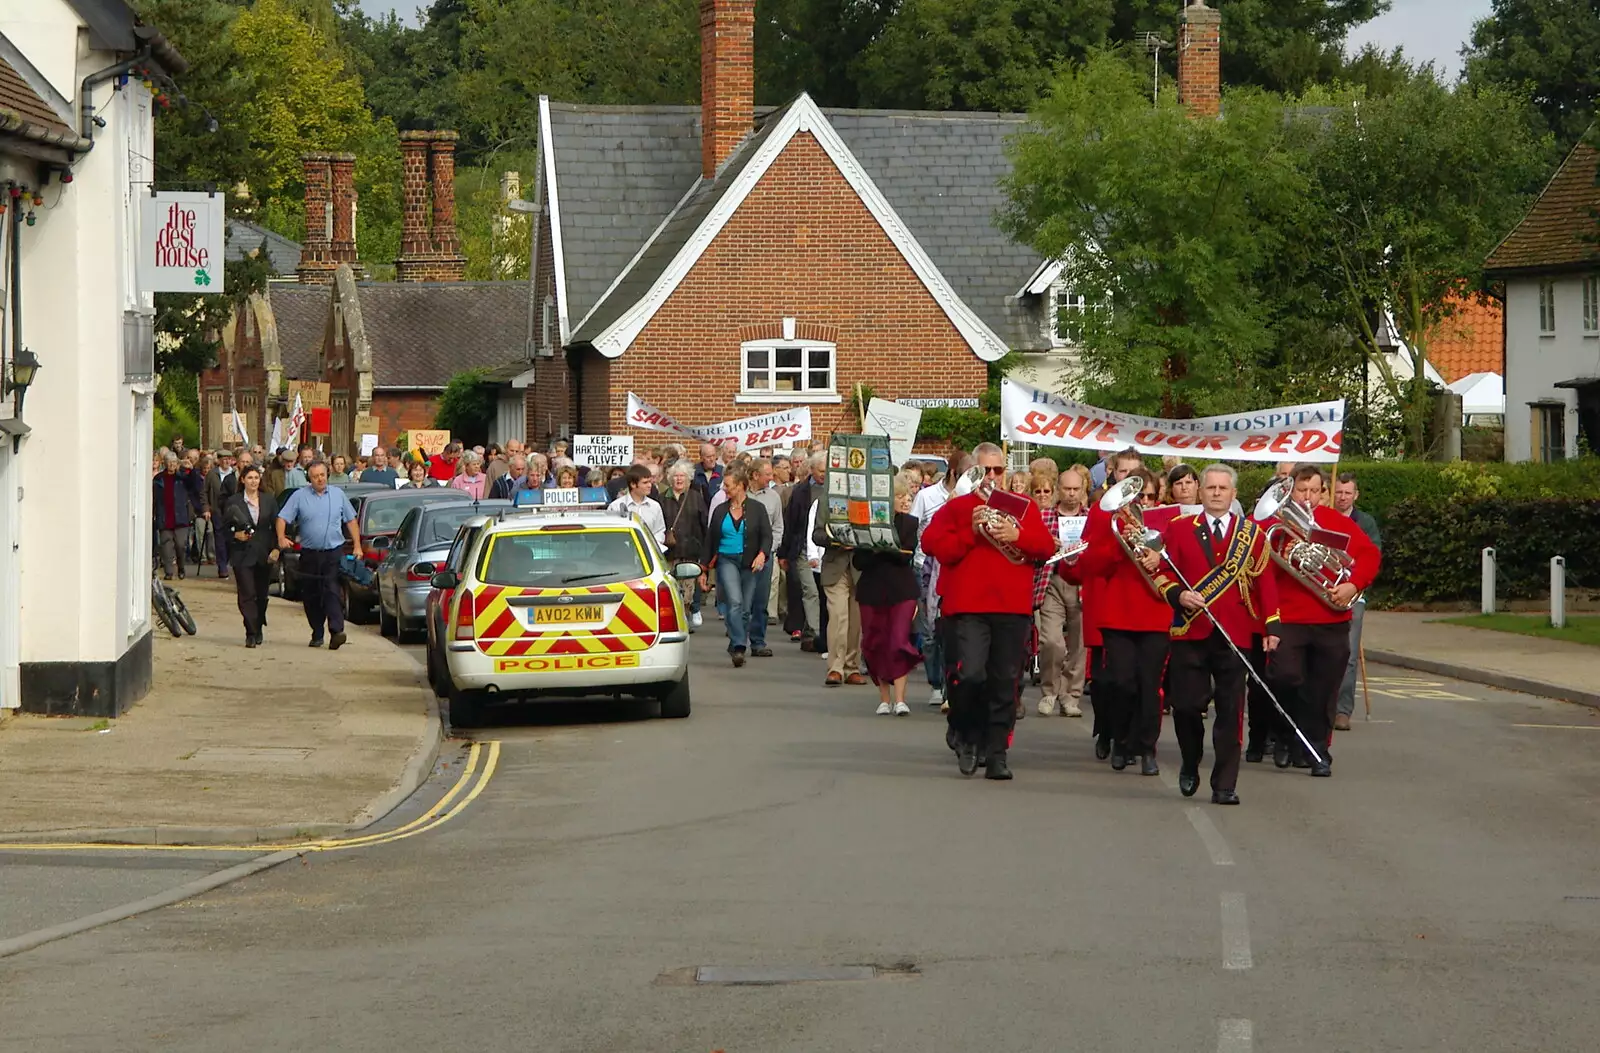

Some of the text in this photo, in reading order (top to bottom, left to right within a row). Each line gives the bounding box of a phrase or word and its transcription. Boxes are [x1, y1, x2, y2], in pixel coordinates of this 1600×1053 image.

[168, 202, 196, 230] the
[159, 222, 193, 249] desi
[156, 241, 208, 268] house
[898, 399, 976, 408] WELLINGTON ROAD
[631, 408, 684, 432] SAV
[745, 423, 802, 446] BEDS
[729, 413, 795, 433] HOSPITAL
[1214, 407, 1342, 432] HOSPITAL
[415, 432, 444, 446] SAVE
[590, 436, 612, 445] KEEP
[1016, 410, 1344, 454] SAVE OUR BEDS
[575, 445, 629, 455] HARTISMERE
[545, 491, 577, 503] POLICE
[536, 607, 572, 622] AV02
[575, 607, 602, 620] KWW
[500, 655, 636, 671] POLICE
